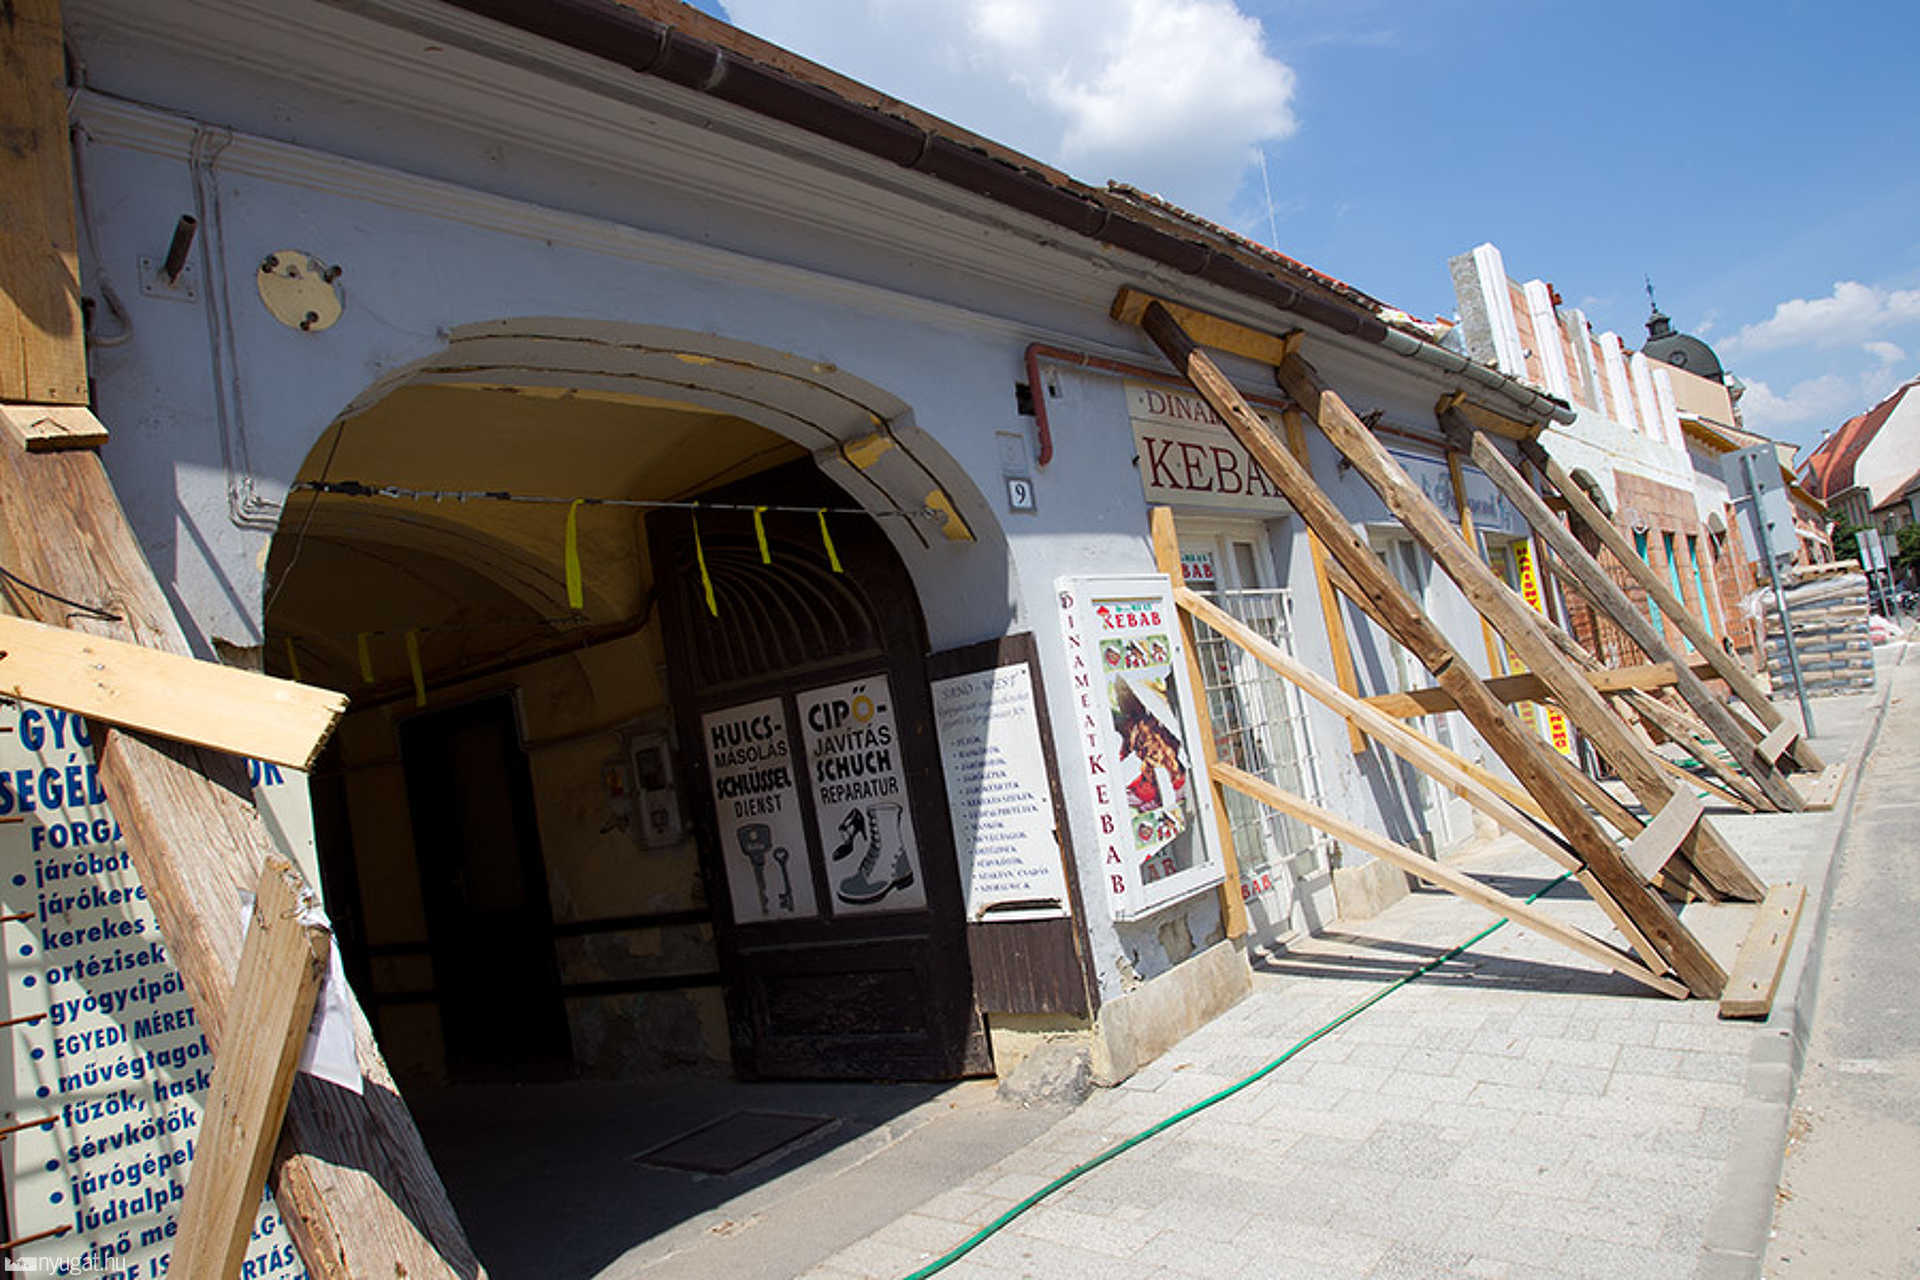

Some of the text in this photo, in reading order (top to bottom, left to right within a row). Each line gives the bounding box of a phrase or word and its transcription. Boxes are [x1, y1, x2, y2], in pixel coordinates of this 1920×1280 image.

[1142, 436, 1284, 497] KEBA
[1015, 483, 1025, 504] 9
[1181, 563, 1213, 578] BAB
[815, 750, 893, 783] SCHUCH
[733, 794, 782, 818] DIENST
[820, 776, 900, 805] REPARATUR
[34, 851, 134, 888] járóbot
[41, 917, 145, 950] kerekes
[46, 942, 166, 984] ortézisek
[54, 1007, 201, 1058] EGYEDI MÉRET
[153, 1065, 215, 1102] hask
